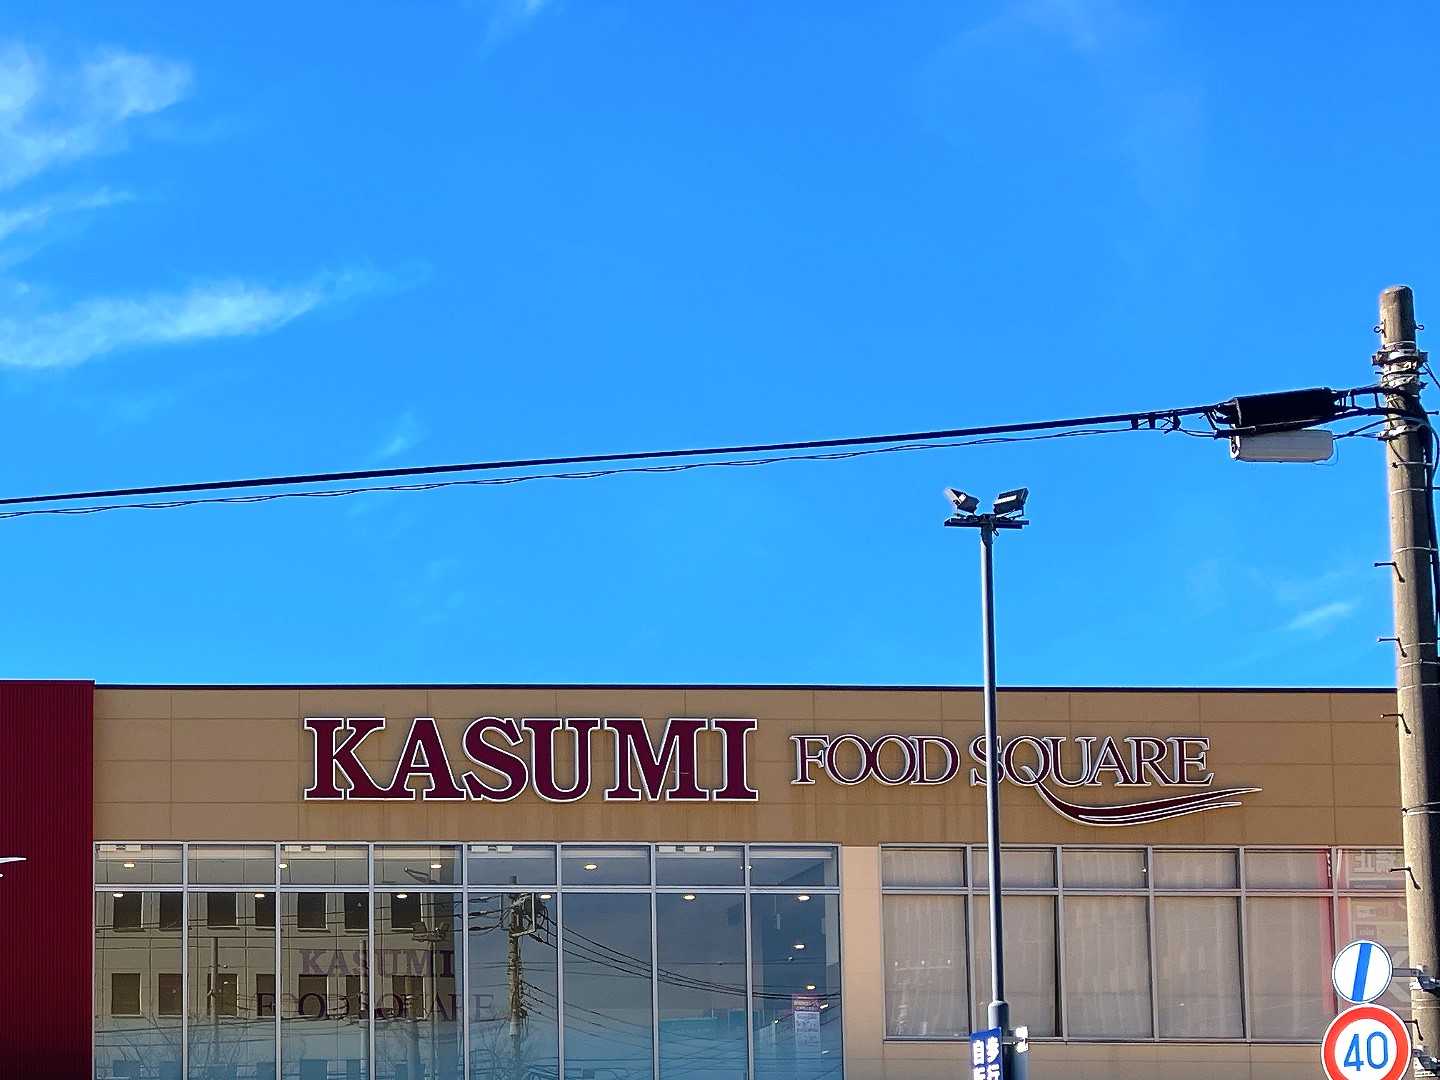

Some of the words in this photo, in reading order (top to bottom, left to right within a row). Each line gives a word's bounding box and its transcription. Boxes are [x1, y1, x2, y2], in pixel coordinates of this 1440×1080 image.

[304, 716, 758, 802] KASUMI
[790, 733, 960, 786] FOOD
[969, 735, 1218, 812] SQUARE
[1344, 1031, 1389, 1072] 40
